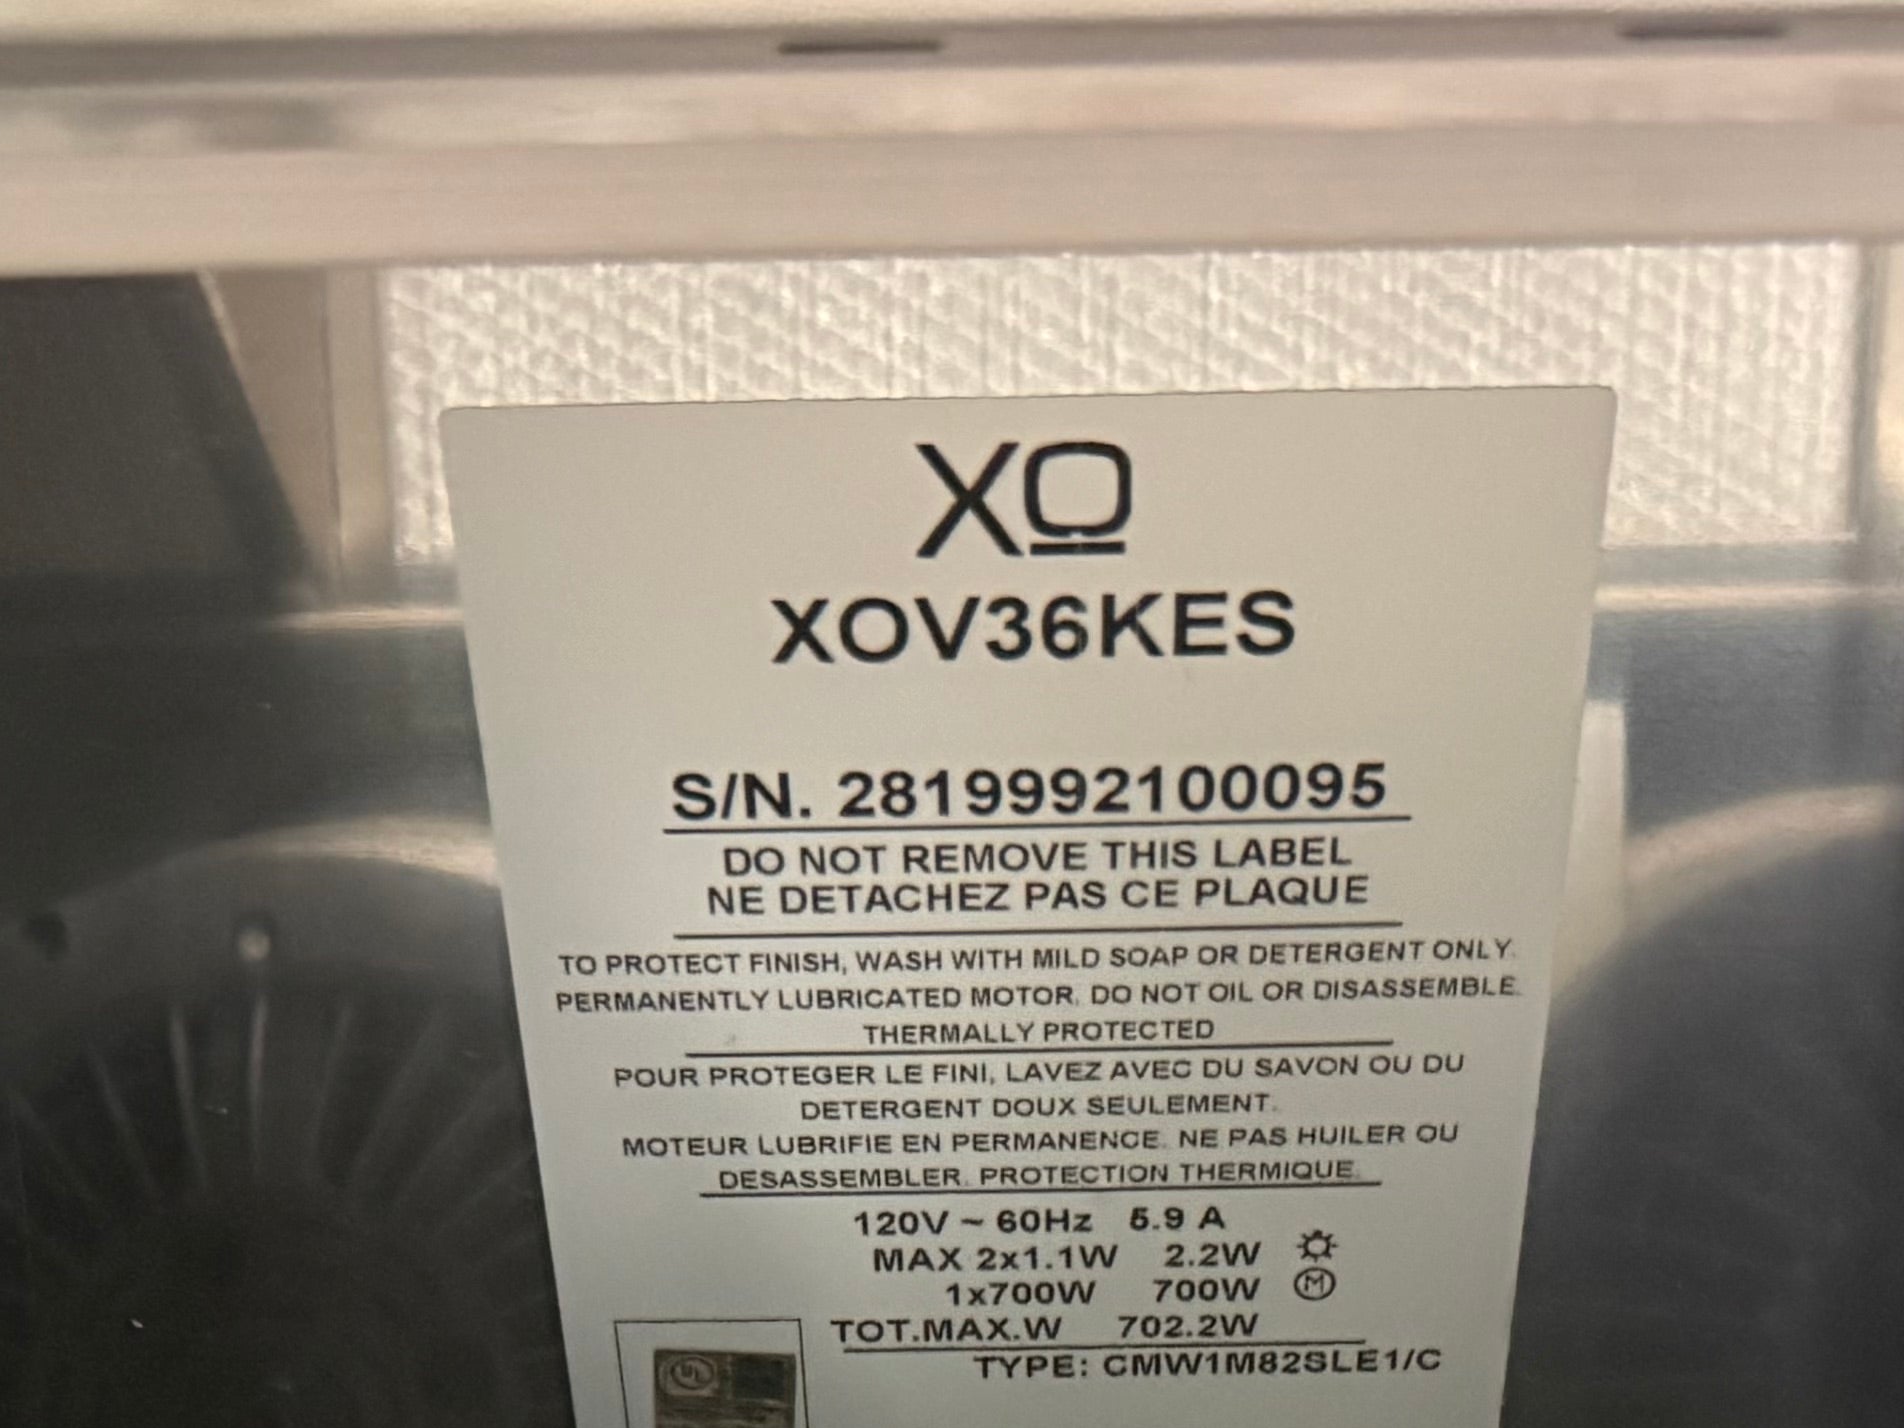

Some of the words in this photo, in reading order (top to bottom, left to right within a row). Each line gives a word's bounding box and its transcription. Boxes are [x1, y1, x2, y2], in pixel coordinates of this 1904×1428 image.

[771, 589, 1298, 665] XOV36KES
[671, 771, 812, 820] S/N.
[839, 762, 1386, 817] 2819992100095
[723, 848, 785, 876] DO
[800, 845, 886, 876] NOT
[903, 841, 1087, 874] REMOVE
[1101, 840, 1197, 869] THIS
[1214, 837, 1352, 868] LABEL
[707, 886, 766, 916] NE
[781, 883, 1011, 914] DETACHEZ
[1025, 881, 1107, 910] PAS
[1120, 879, 1179, 909] CE
[1195, 876, 1369, 907] PLAQUE
[558, 955, 596, 976] TO
[606, 953, 739, 975] PROTECT
[750, 952, 848, 975] FINISH,
[855, 950, 941, 972] WASH
[950, 949, 1022, 970] WITH
[1033, 948, 1099, 969] MILD
[1109, 946, 1189, 967] SOAP
[1198, 945, 1237, 965] OR
[1249, 941, 1423, 965] DETERGENT
[555, 990, 768, 1013] PERMANENTLY
[778, 987, 960, 1010] LUBRICATED
[970, 985, 1079, 1008] MOTOR.
[1091, 984, 1132, 1005] DO
[1141, 983, 1200, 1004] NOT
[1209, 982, 1252, 1002] OIL
[1262, 980, 1304, 1001] OR
[863, 1021, 1034, 1045] THERMALLY
[1043, 1019, 1214, 1042] PROTECTED
[614, 1066, 698, 1087] POUR
[710, 1065, 875, 1086] PROTEGER
[886, 1064, 922, 1084] LE
[933, 1063, 996, 1086] FINI,
[1006, 1060, 1102, 1082] LAVEZ
[1109, 1059, 1191, 1080] AVEC
[1203, 1058, 1242, 1078] DU
[1254, 1055, 1358, 1076] SAVON
[1369, 1055, 1411, 1074] OU
[1423, 1054, 1464, 1073] DU
[801, 1099, 982, 1120] DETERGENT
[994, 1097, 1075, 1118] DOUX
[622, 1136, 748, 1157] MOTEUR
[758, 1134, 893, 1156] LUBRIFIE
[902, 1133, 941, 1154] EN
[1178, 1128, 1218, 1147] NE
[1228, 1127, 1286, 1146] PAS
[1298, 1124, 1405, 1145] HUILER
[1416, 1123, 1458, 1143] OU
[980, 1163, 1168, 1184] PROTECTION
[855, 1211, 949, 1236] 120V
[997, 1209, 1092, 1233] 60Hz
[1129, 1207, 1184, 1231] 5.9
[1199, 1206, 1226, 1230] A
[874, 1247, 962, 1271] MAX
[976, 1244, 1117, 1270] 2x1.1W
[1165, 1241, 1261, 1267] 2.2W
[945, 1282, 1096, 1306] 1x700W
[1153, 1278, 1260, 1303] 700W
[830, 1317, 1062, 1342] TOT.MAX.W
[1117, 1314, 1259, 1337] 702.2W
[974, 1354, 1089, 1378] TYPE:
[1103, 1348, 1441, 1377] CMW1M82SLE1/C
